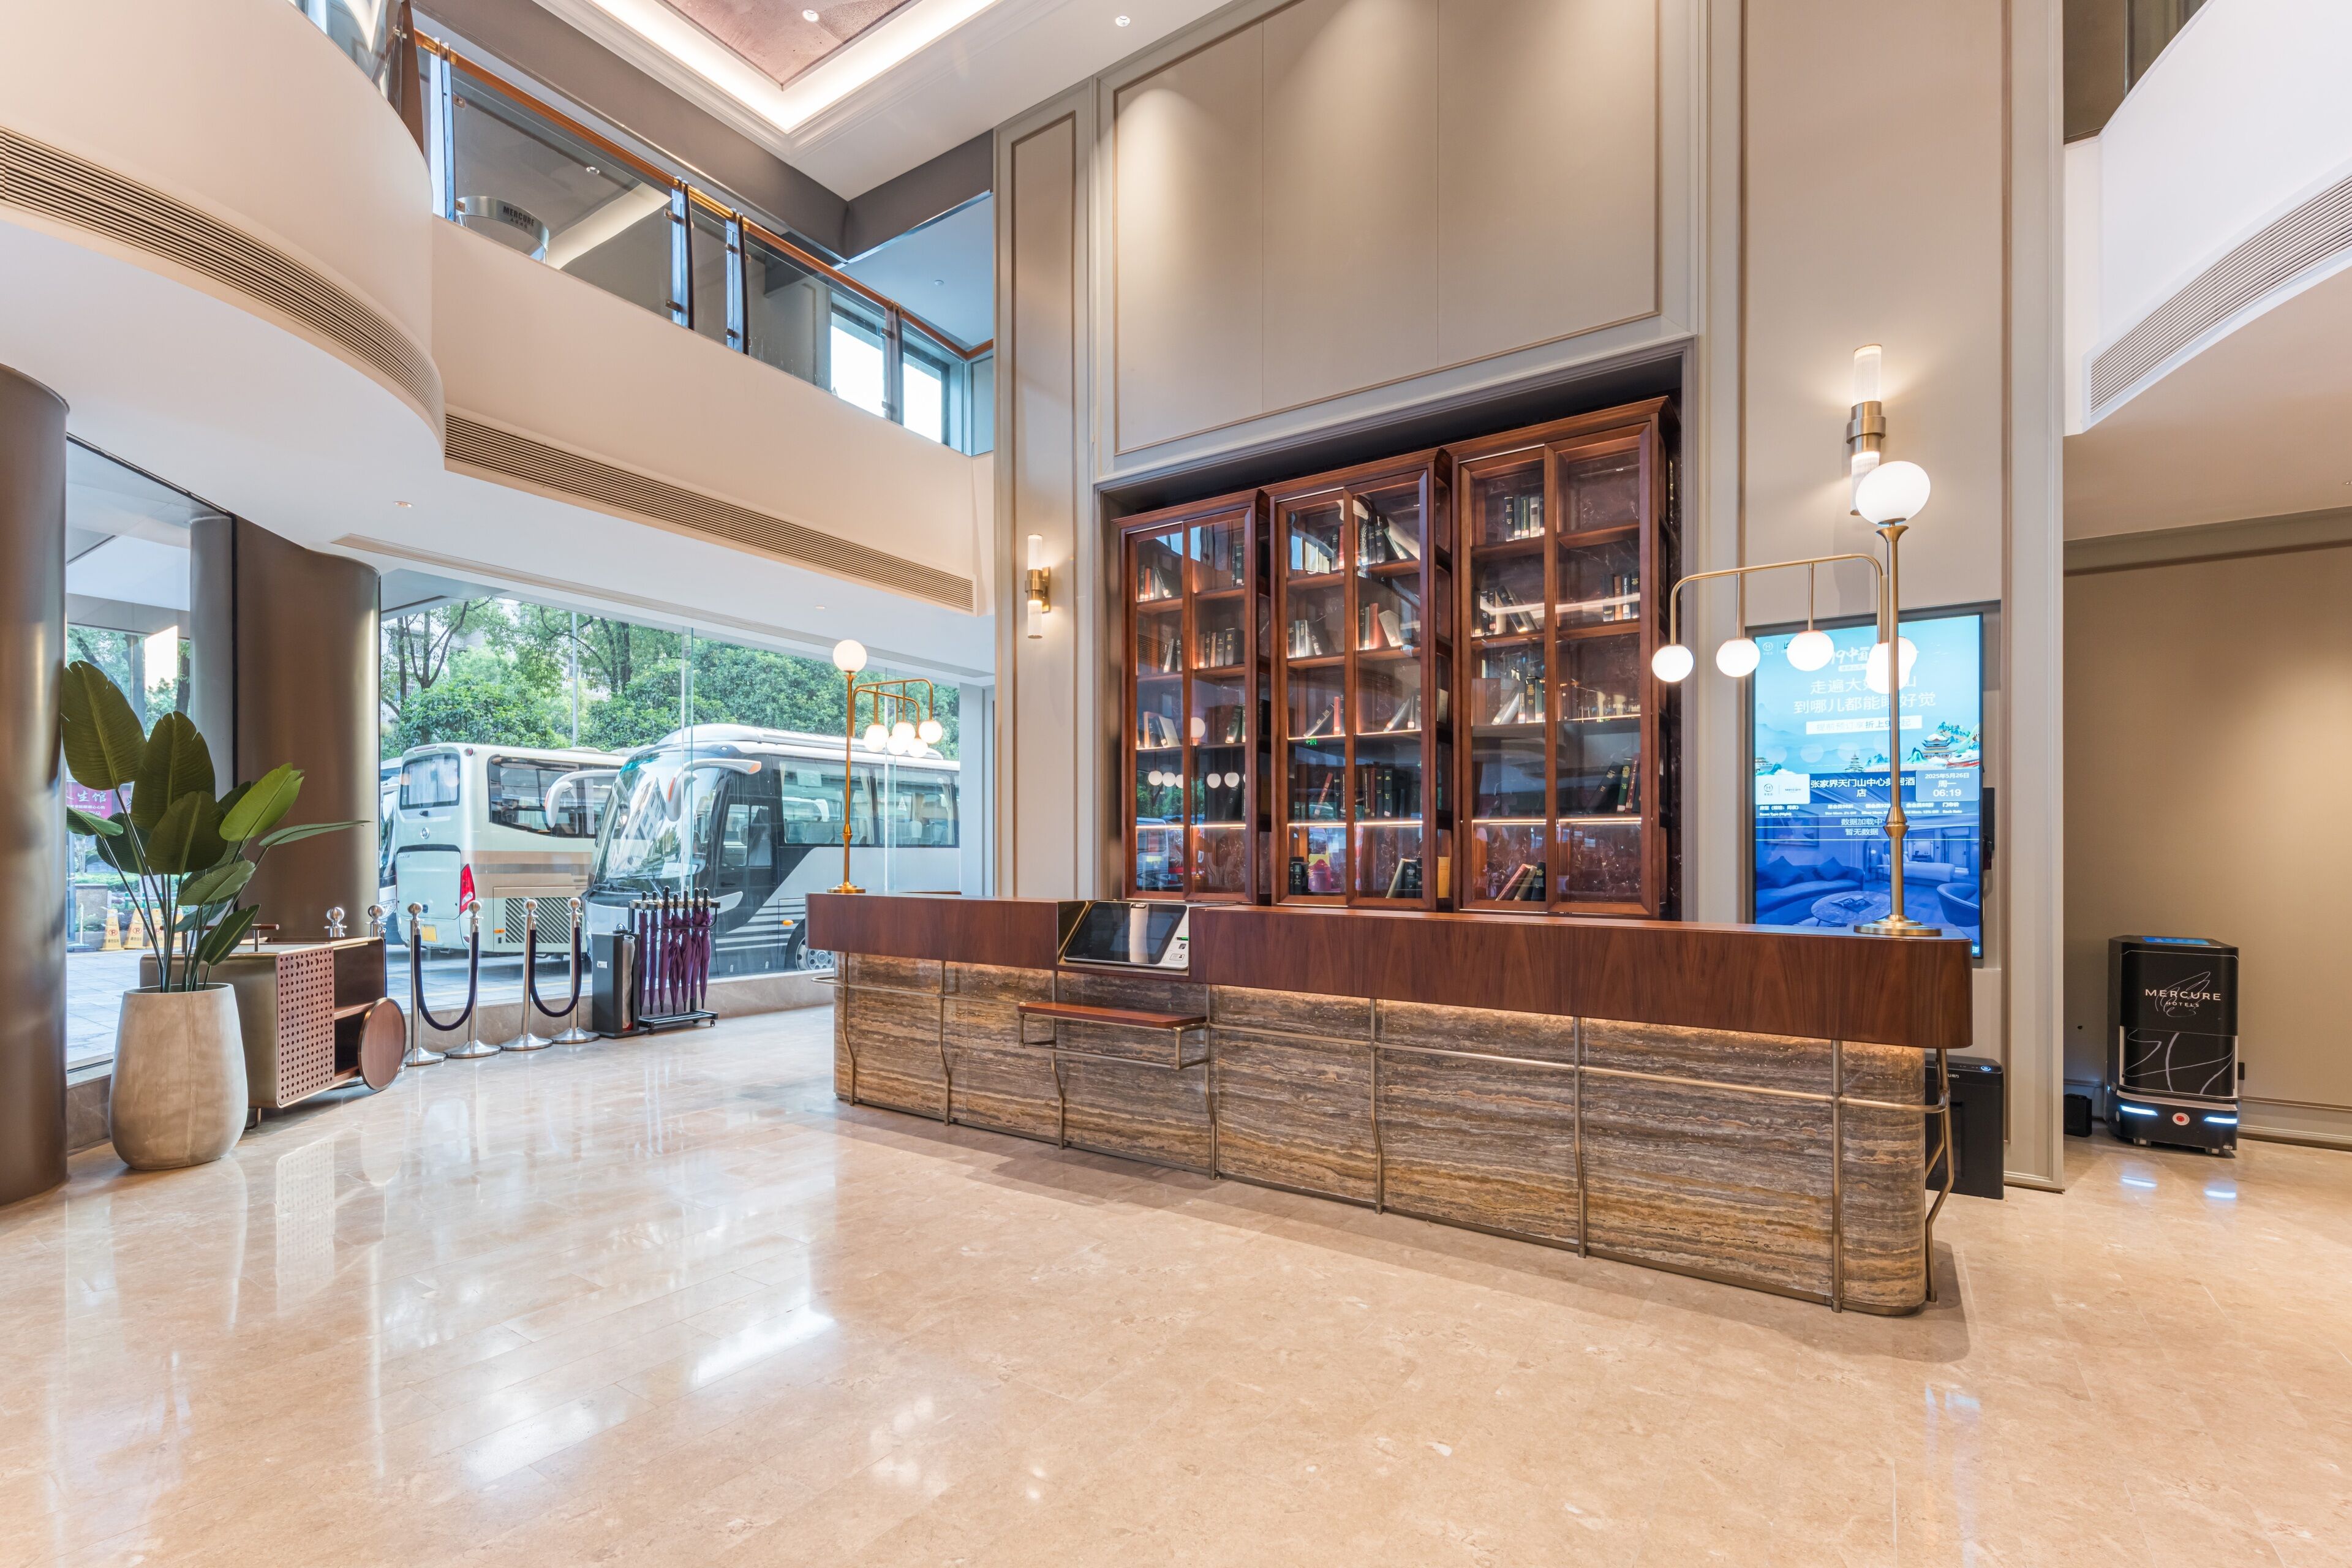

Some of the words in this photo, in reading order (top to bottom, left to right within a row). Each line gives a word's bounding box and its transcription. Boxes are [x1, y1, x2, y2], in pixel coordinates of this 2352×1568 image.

[503, 205, 534, 226] MERCURE
[1817, 719, 1912, 731] 提前预订享折上9起
[1856, 789, 1867, 797] 店
[2145, 989, 2221, 1001] MERCURE
